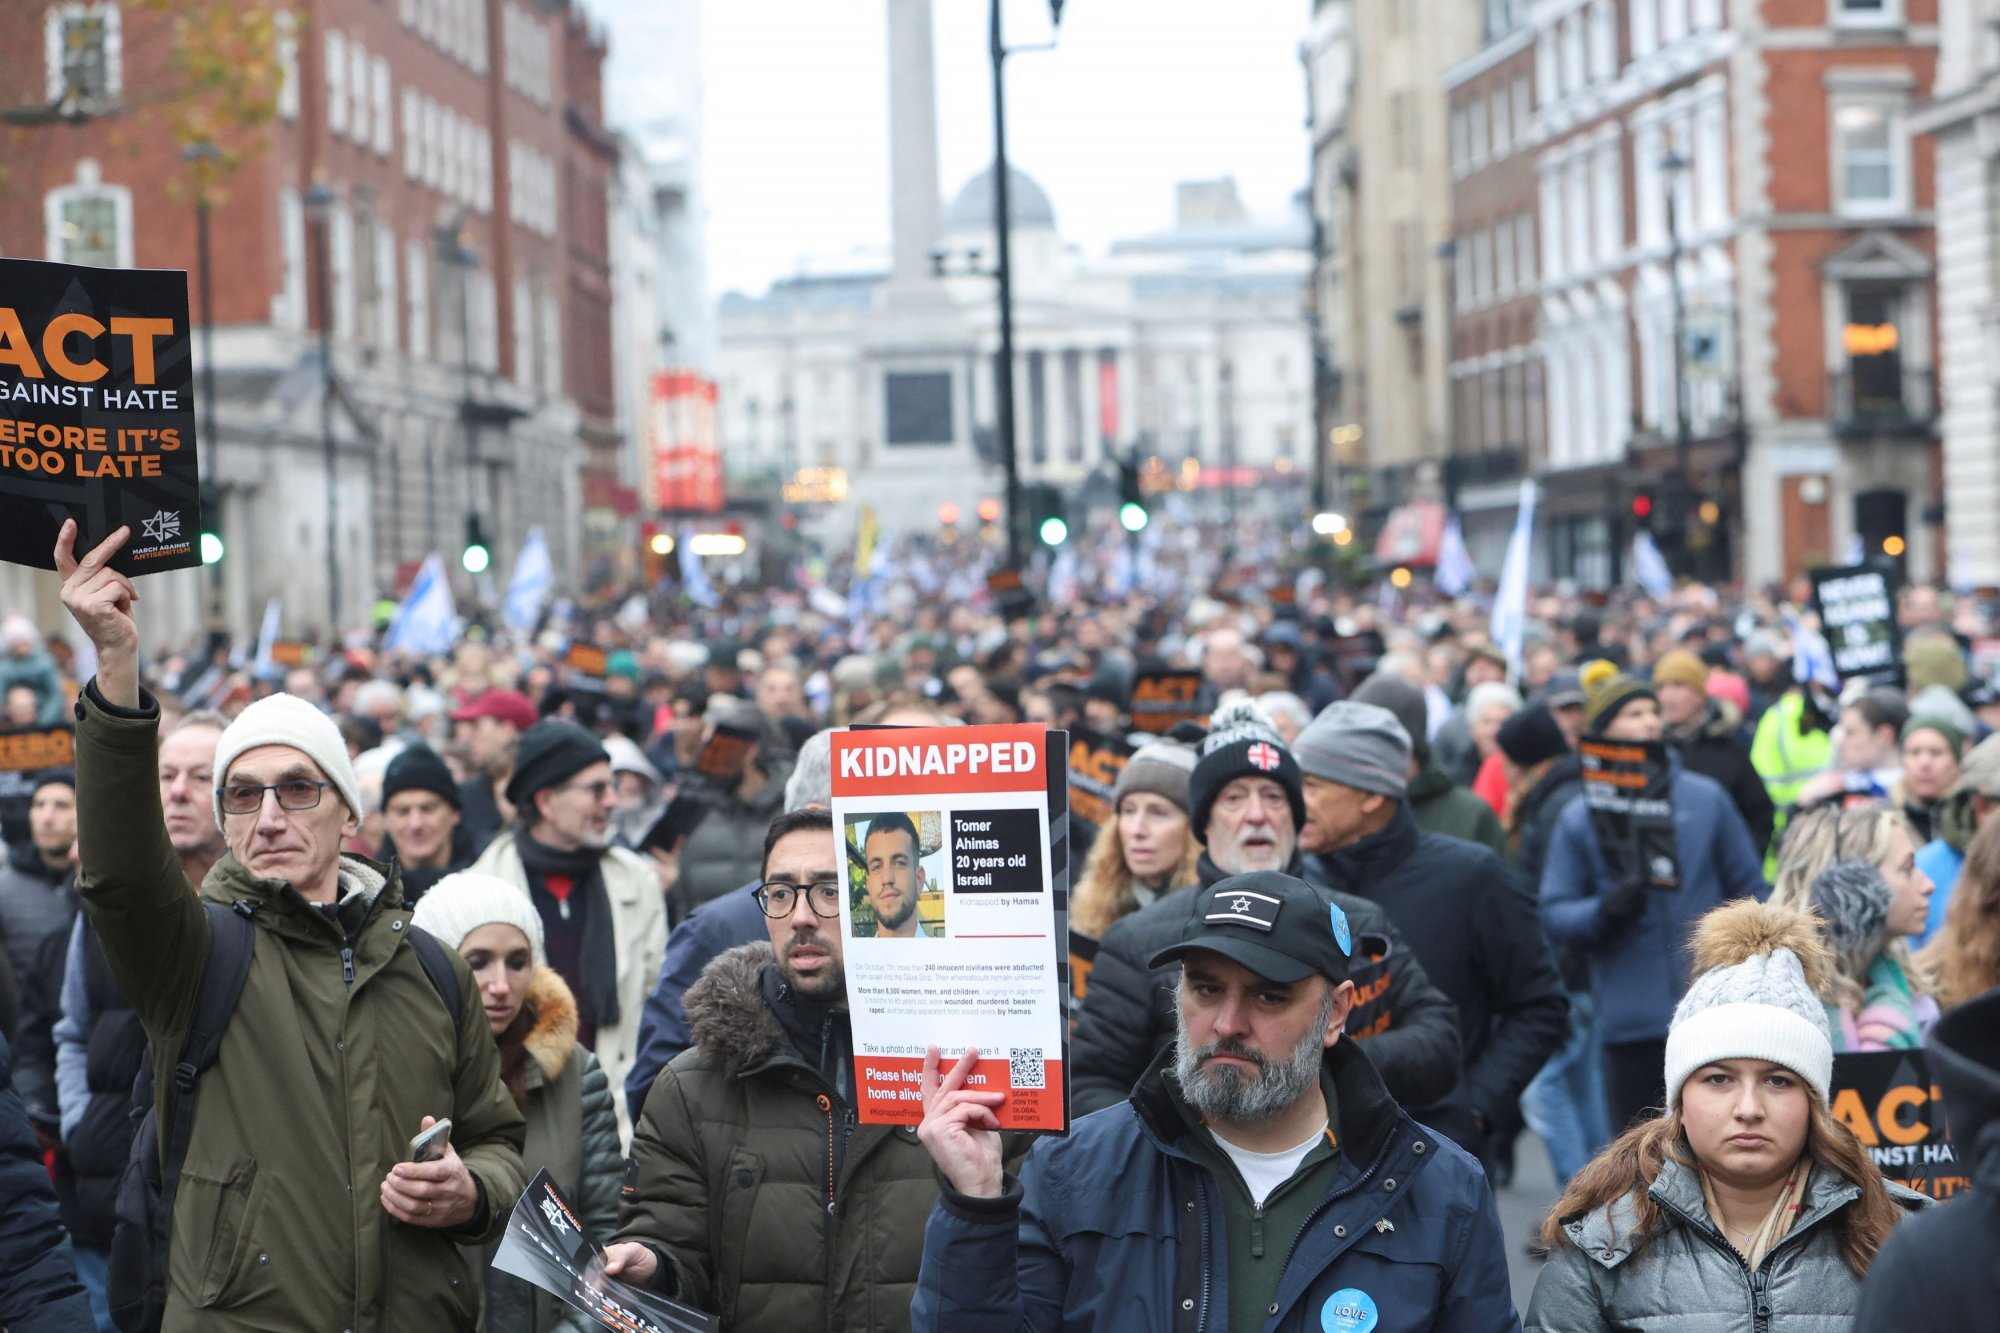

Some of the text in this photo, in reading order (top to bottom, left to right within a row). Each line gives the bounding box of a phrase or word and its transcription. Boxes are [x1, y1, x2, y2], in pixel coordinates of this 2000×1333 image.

[0, 307, 174, 385] ACT
[0, 381, 178, 410] GAINST HATE
[0, 419, 181, 452] EFORE IT'S
[0, 444, 162, 478] TOO LATE
[132, 541, 190, 555] MARCH AGAINST
[133, 547, 191, 561] ANTISEMITISM
[840, 741, 1036, 778] KIDNAPPED
[955, 819, 992, 832] Tomer
[955, 836, 999, 850] Ahimas
[956, 854, 1026, 871] 20 years old
[957, 873, 992, 886] Israeli
[959, 897, 1039, 907] Kidnapped by Hamas
[936, 963, 964, 971] innocent
[965, 963, 993, 971] civilians
[1012, 963, 1045, 971] abducted
[997, 1008, 1006, 1016] by
[863, 1043, 879, 1053] Take
[886, 1044, 905, 1055] photo
[906, 1044, 913, 1054] of
[914, 1044, 926, 1054] this
[938, 1046, 949, 1055] ter
[950, 1046, 966, 1056] and
[978, 1047, 992, 1055] are
[994, 1047, 1000, 1056] it
[865, 1067, 899, 1082] Please
[901, 1069, 923, 1085] help
[867, 1086, 922, 1101] home alive
[1830, 1084, 1943, 1146] AC
[1923, 1144, 1959, 1163] HA
[1334, 1305, 1368, 1321] LOVE
